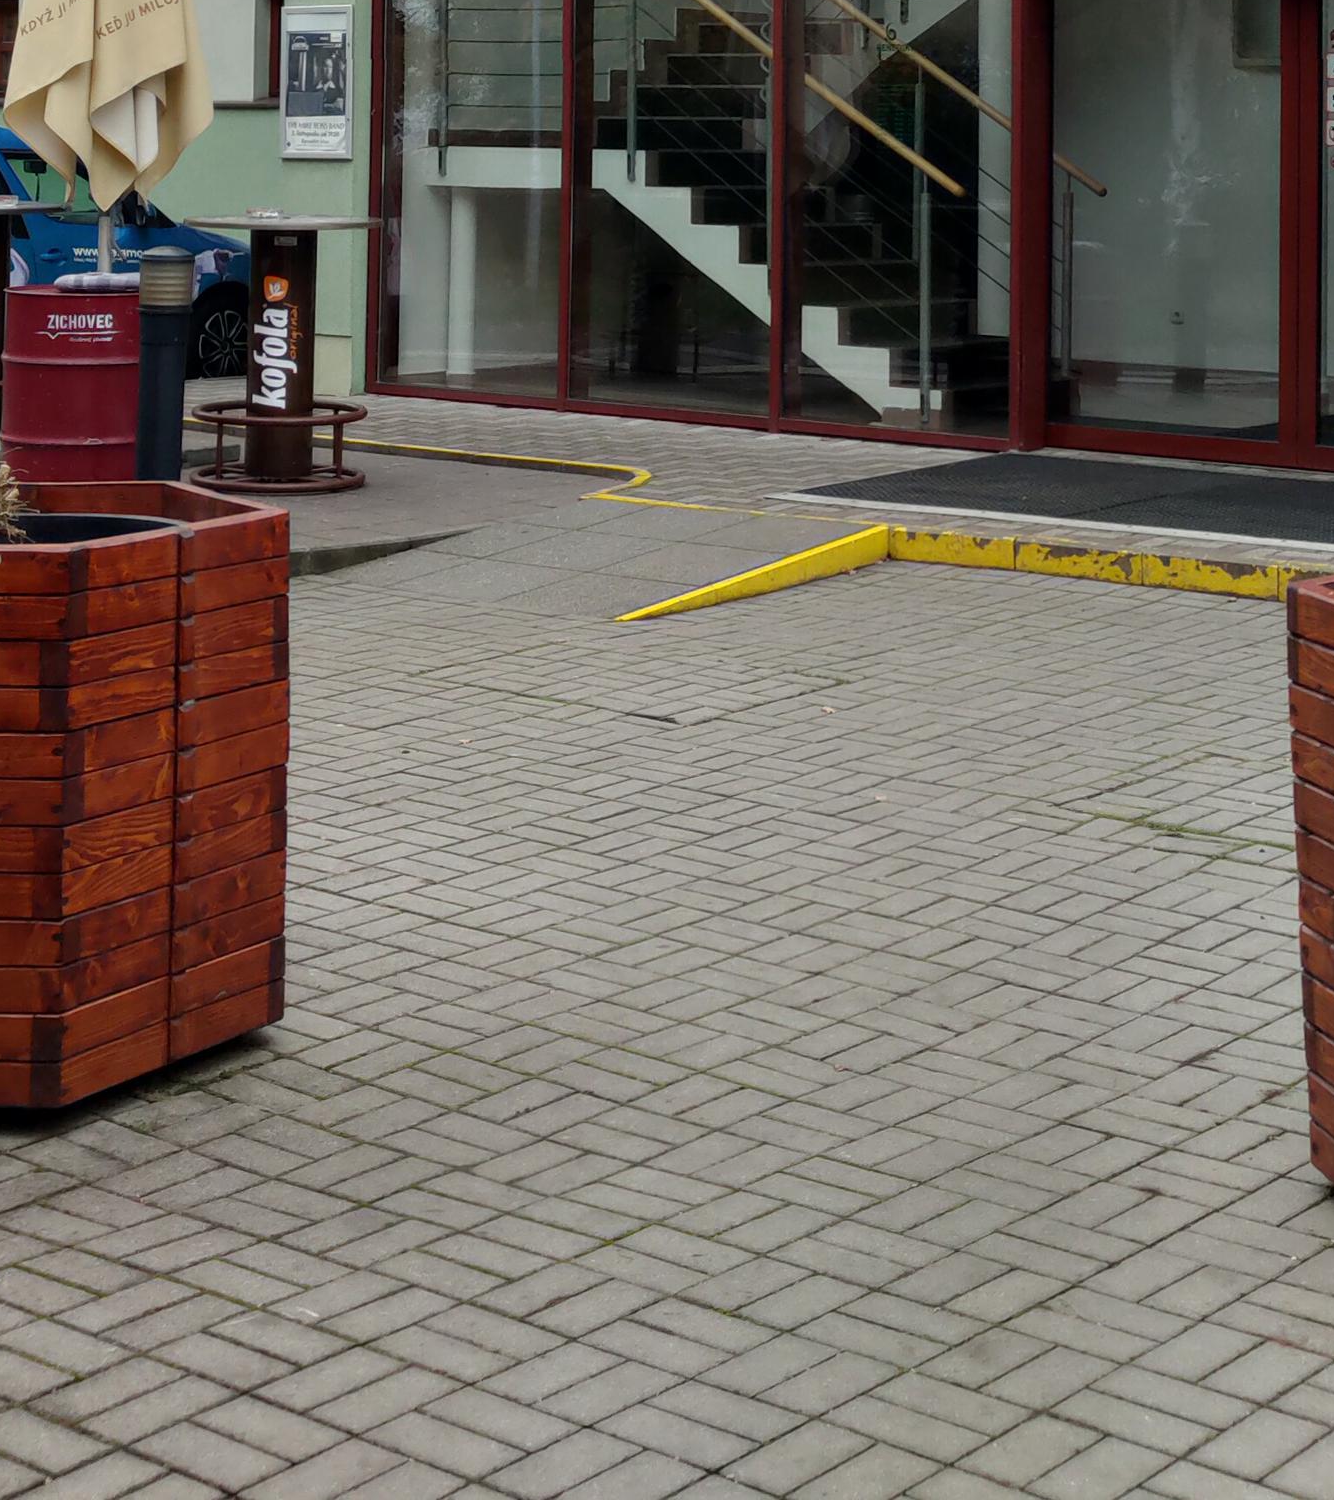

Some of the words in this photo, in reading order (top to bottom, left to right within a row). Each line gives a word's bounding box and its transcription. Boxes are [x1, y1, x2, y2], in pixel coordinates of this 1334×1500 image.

[20, 7, 55, 37] KDYŽ
[57, 1, 67, 19] JI
[95, 15, 123, 40] KEĎ
[125, 8, 137, 28] JU
[46, 313, 114, 330] ZICHOVEC
[282, 301, 304, 360] original
[251, 306, 298, 410] kofola
